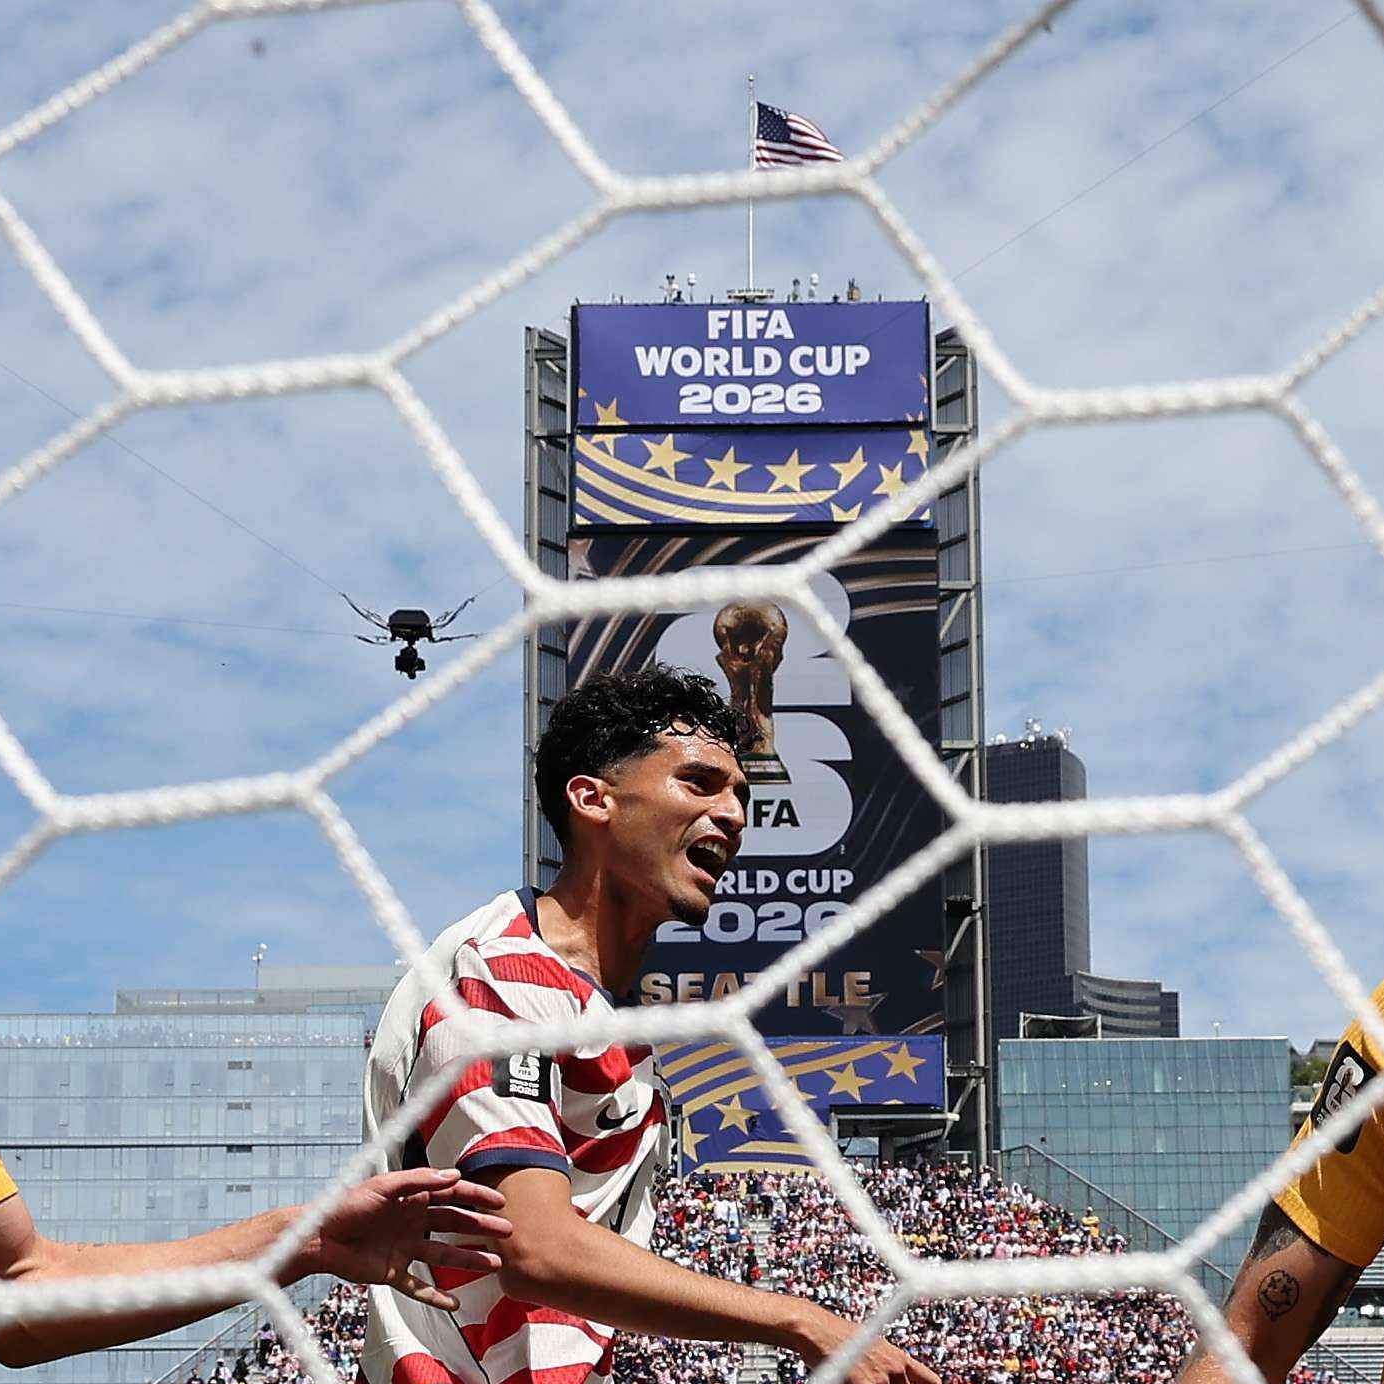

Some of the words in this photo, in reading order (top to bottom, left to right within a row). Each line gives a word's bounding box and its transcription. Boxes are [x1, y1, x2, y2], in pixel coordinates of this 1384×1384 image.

[707, 309, 795, 340] FIFA
[634, 346, 783, 377] WORLD
[789, 344, 871, 376] CUP
[678, 382, 824, 415] 2026
[714, 869, 780, 895] RLD
[785, 868, 854, 895] CUP
